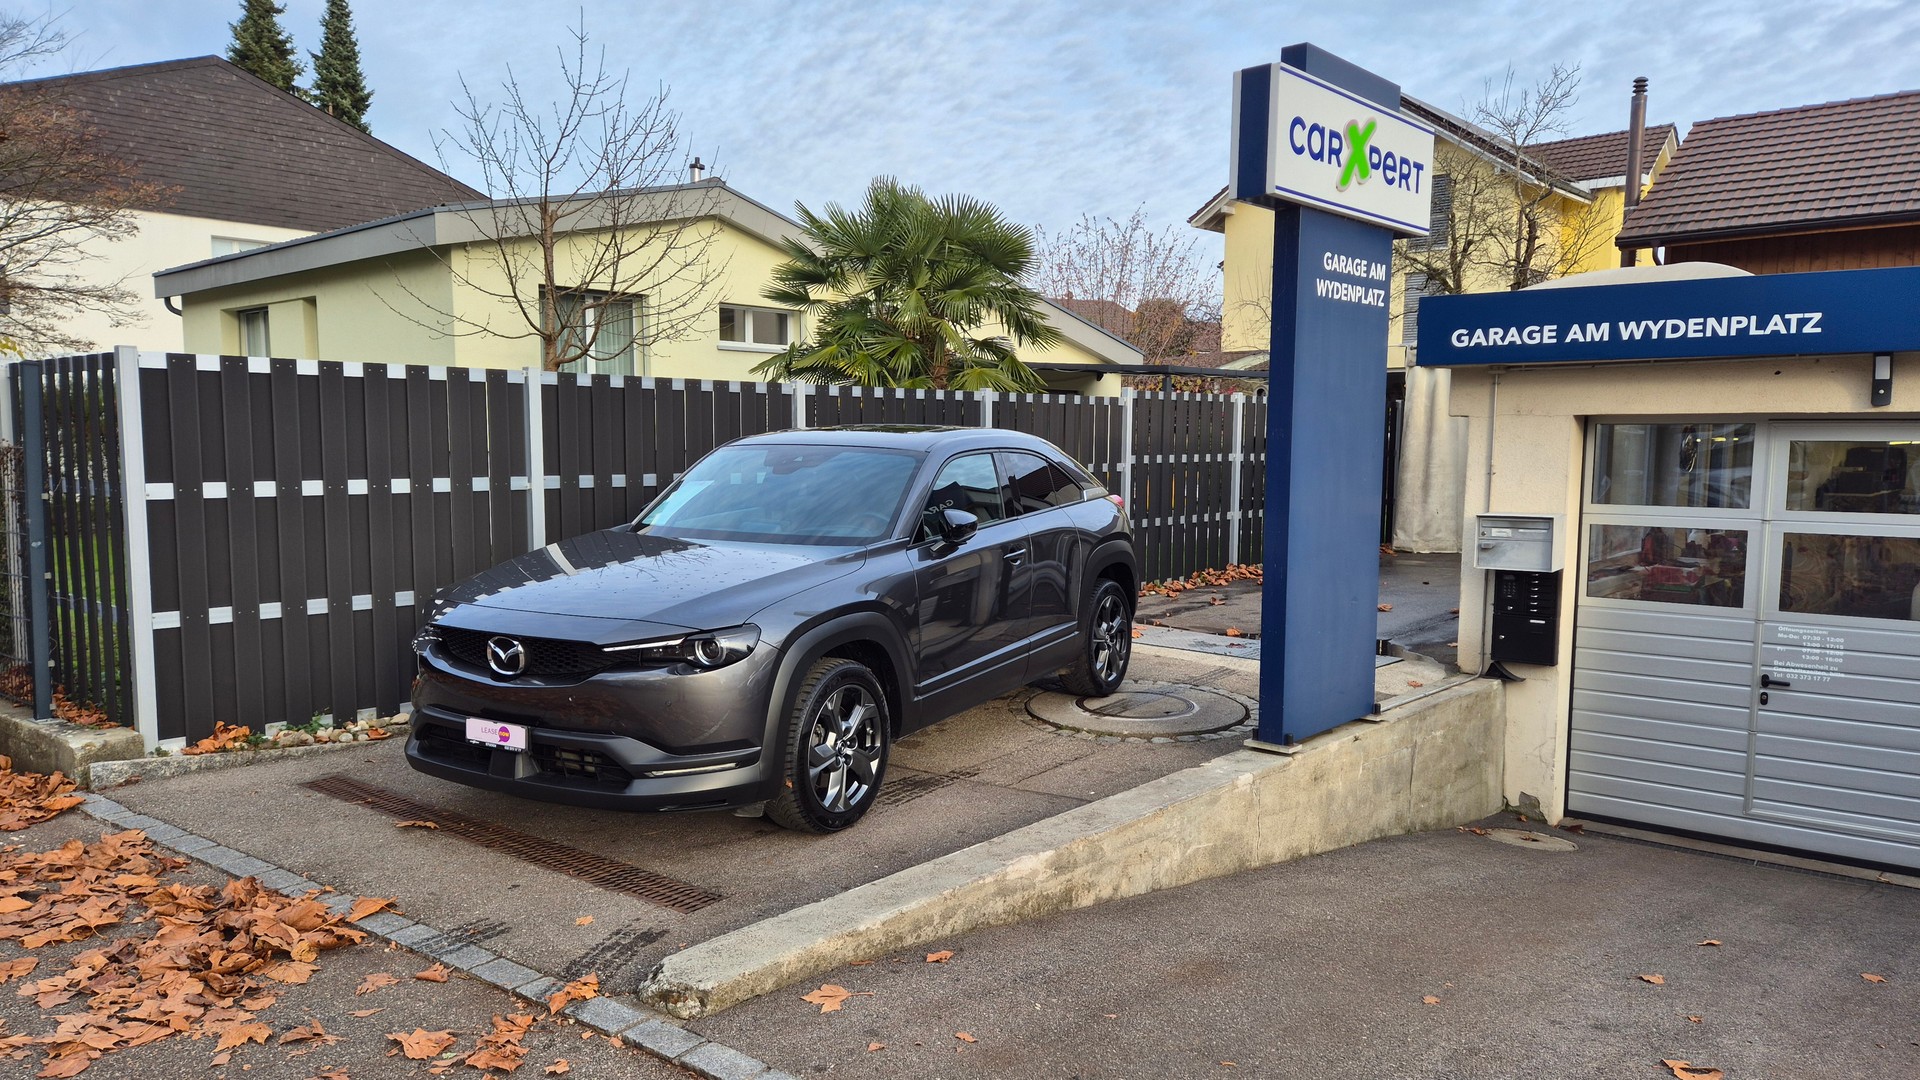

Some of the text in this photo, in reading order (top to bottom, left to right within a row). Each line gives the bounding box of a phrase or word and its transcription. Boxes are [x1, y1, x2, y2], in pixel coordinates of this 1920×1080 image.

[1323, 251, 1386, 281] GARAGE AM
[1316, 278, 1385, 307] WYDENPLATZ
[1450, 312, 1823, 348] GARAGE AM WYDENPLATZ
[481, 727, 498, 736] LEASE
